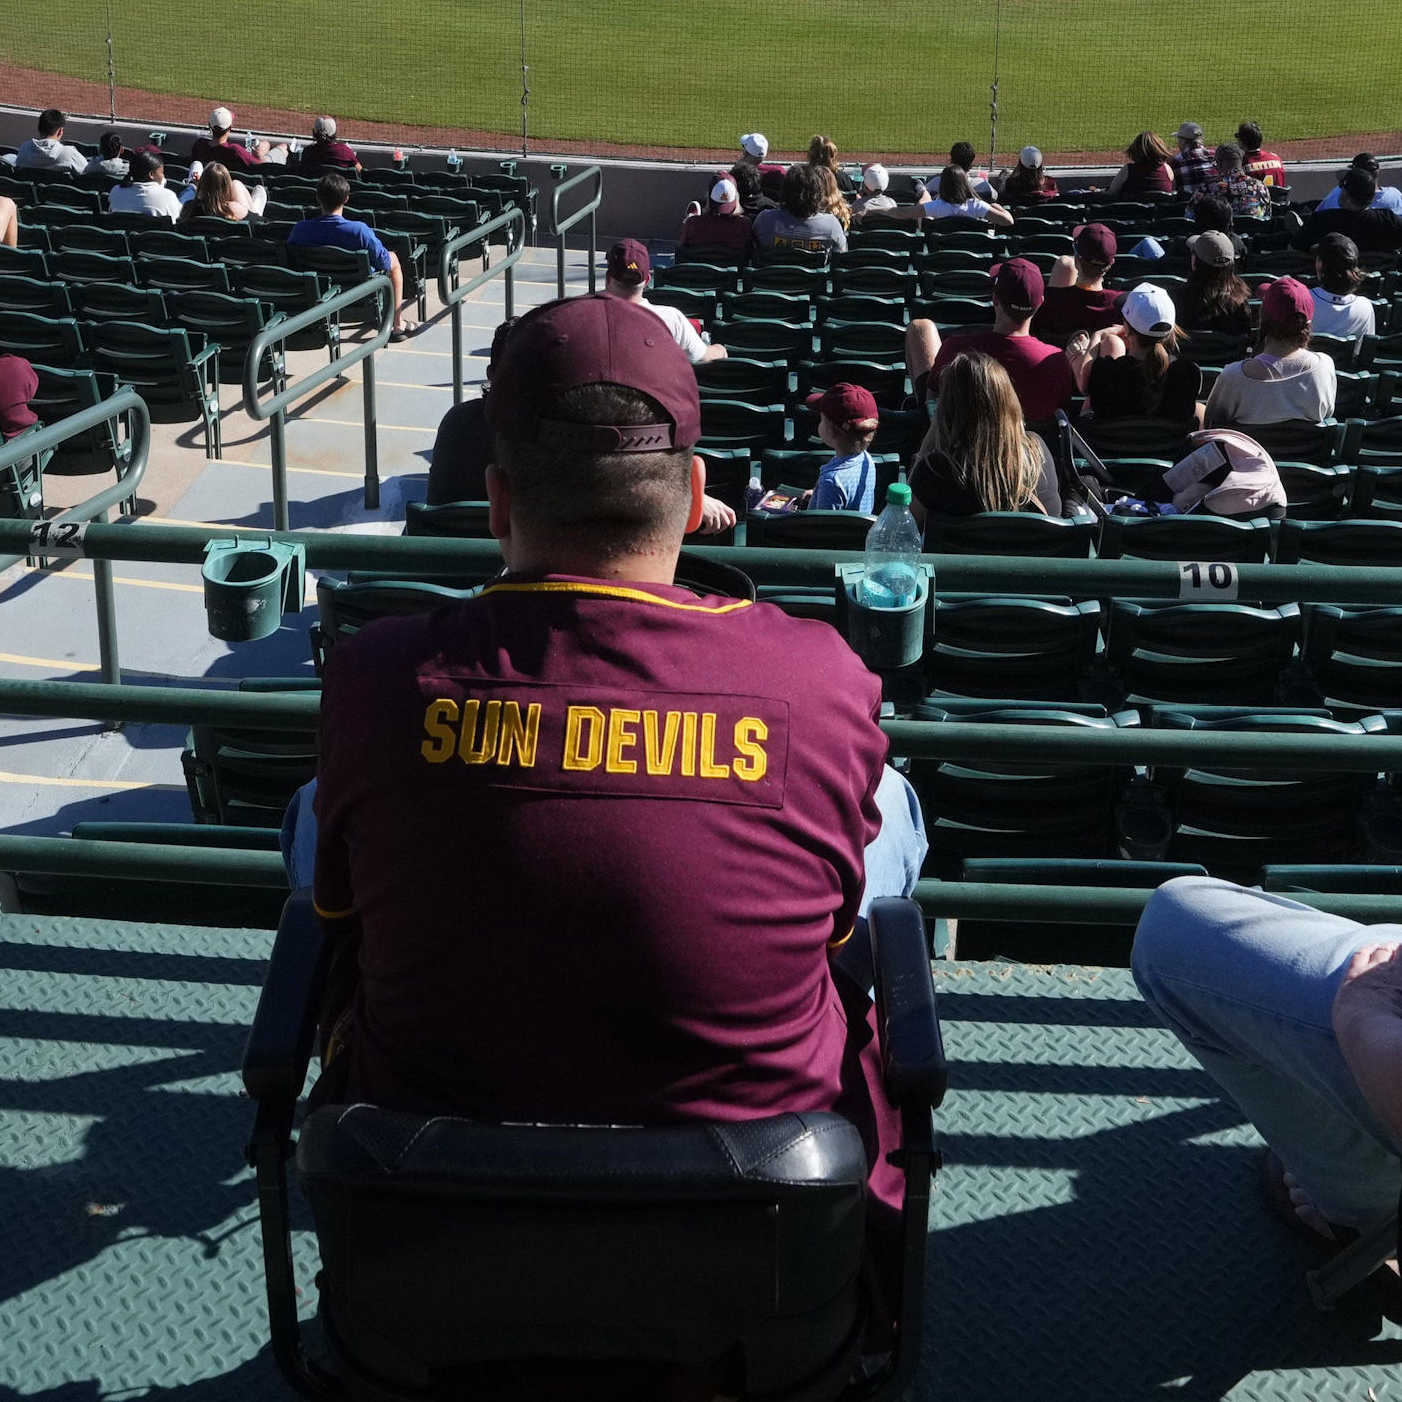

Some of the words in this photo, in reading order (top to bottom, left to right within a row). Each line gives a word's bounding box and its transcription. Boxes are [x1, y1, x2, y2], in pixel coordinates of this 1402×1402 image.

[31, 522, 84, 550] 12
[1181, 561, 1233, 591] 10
[421, 698, 542, 768] SUN
[562, 705, 769, 782] DEVILS
